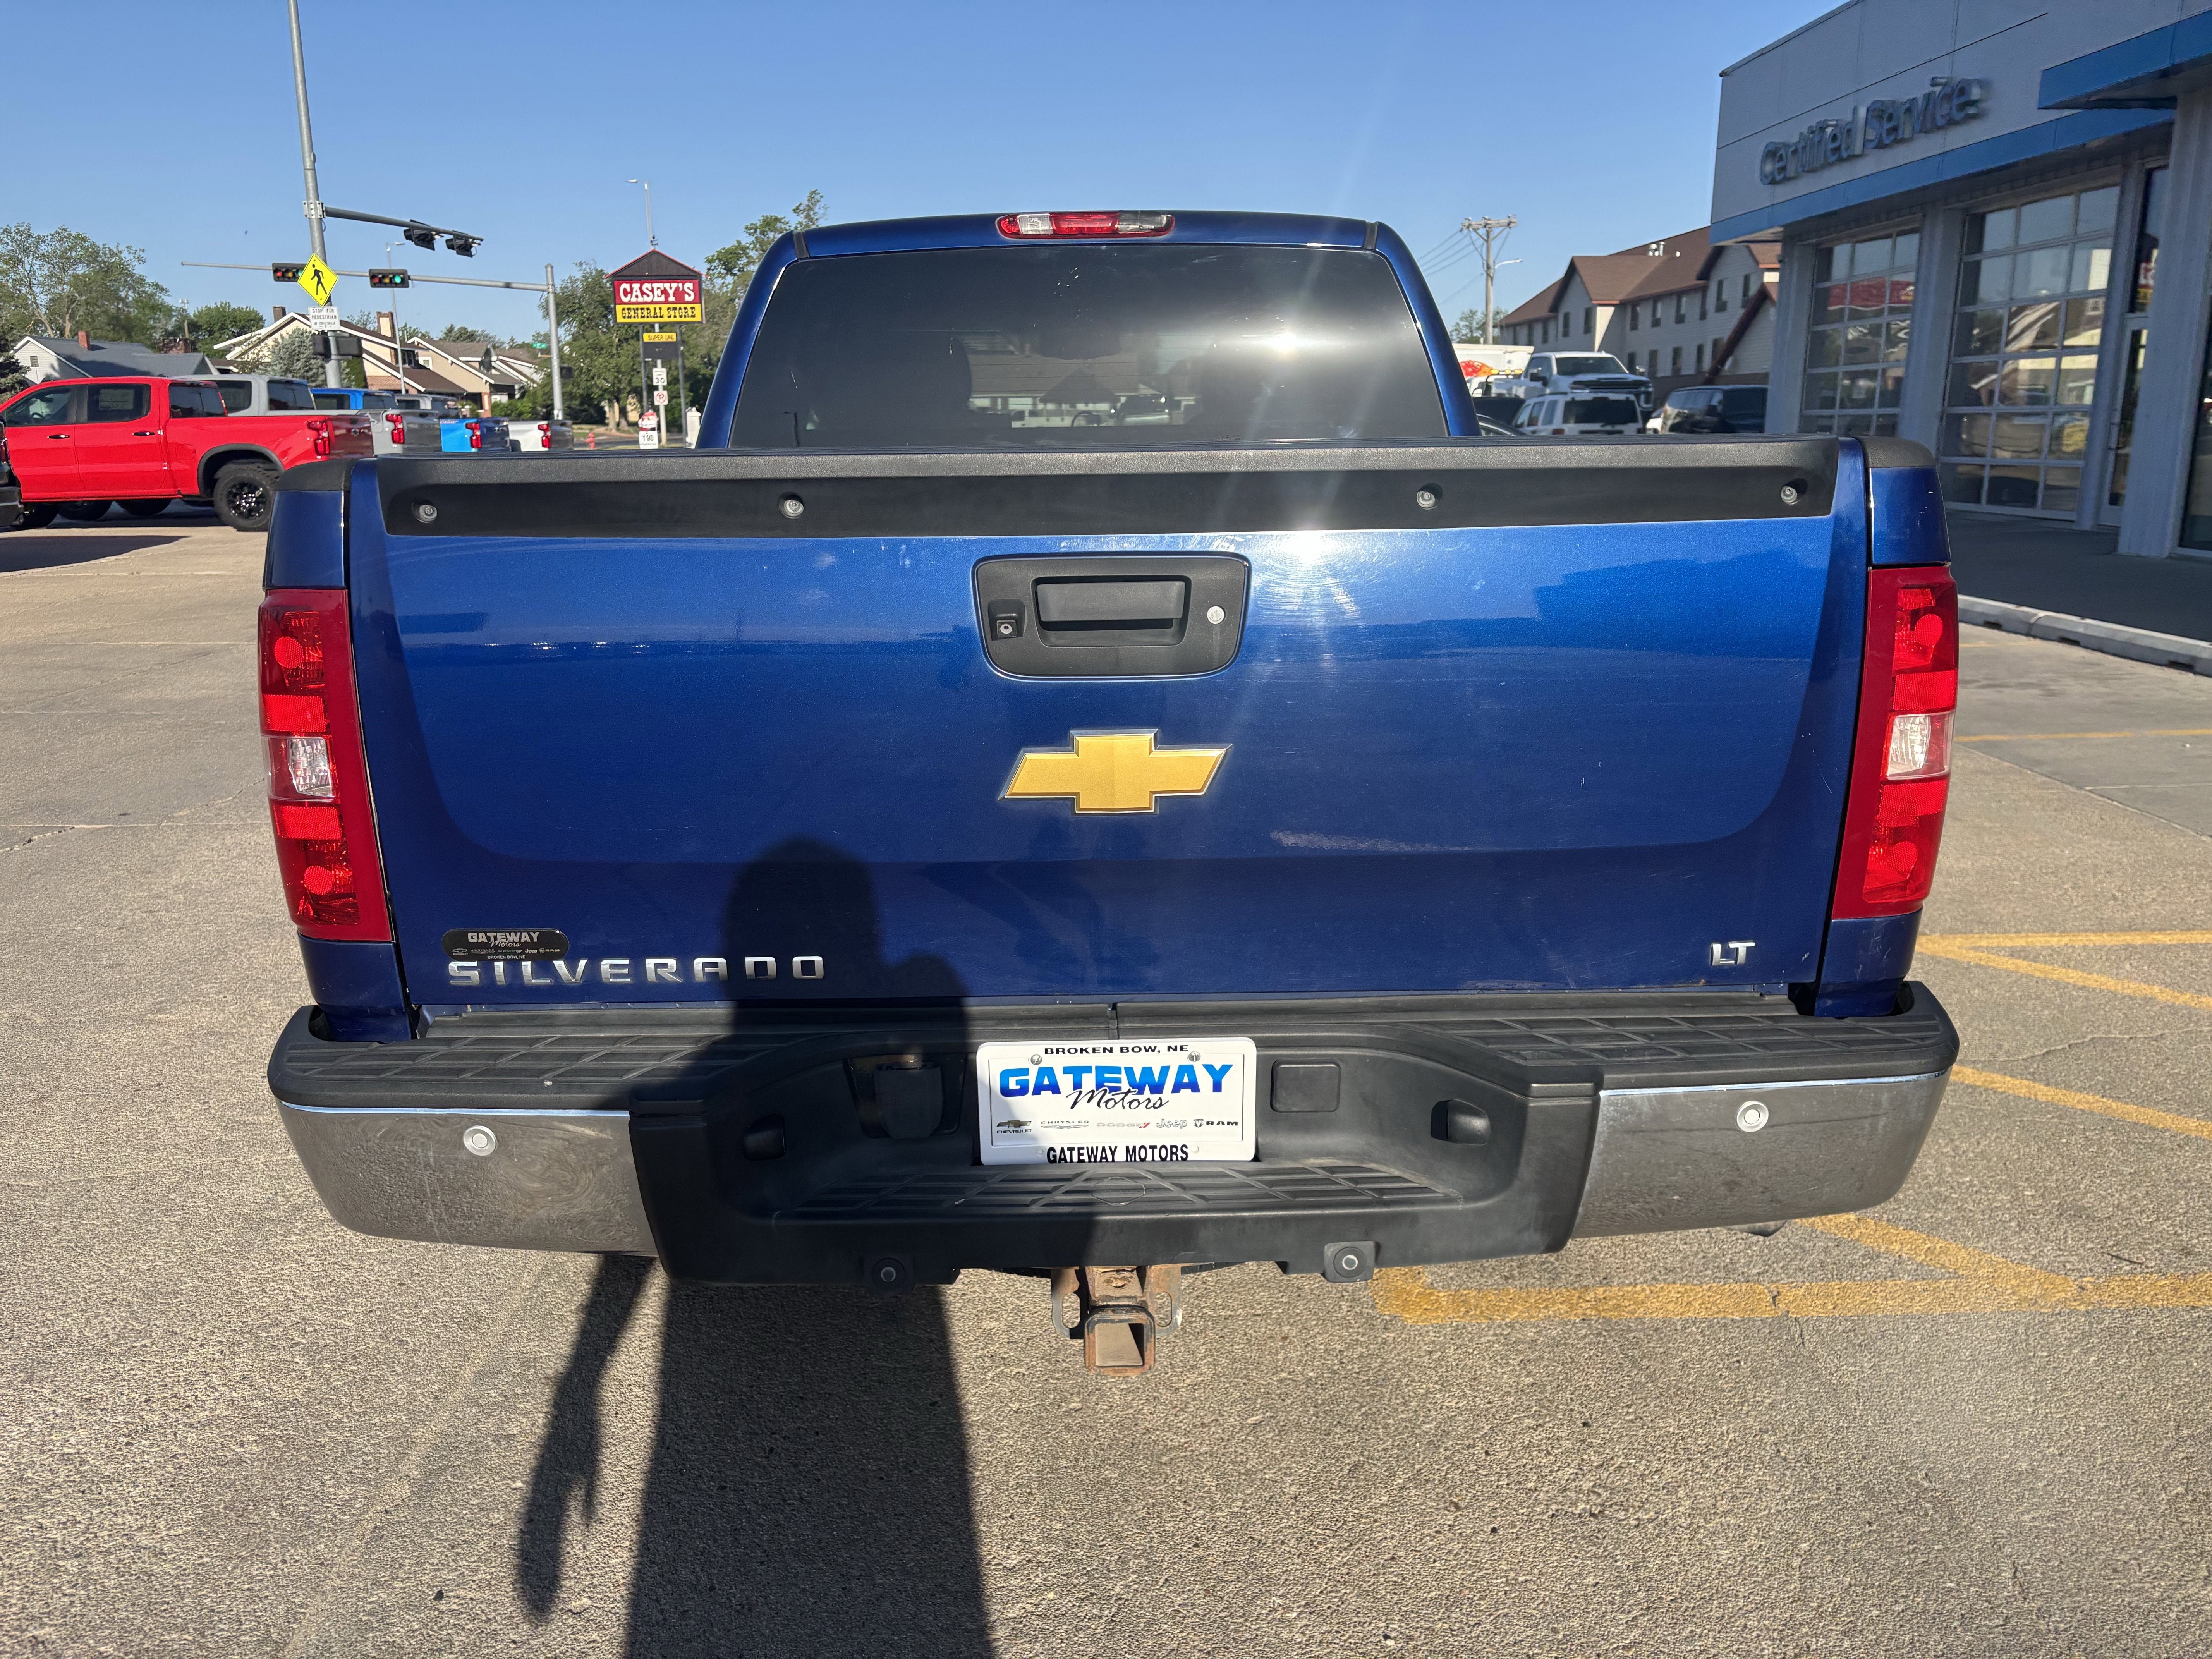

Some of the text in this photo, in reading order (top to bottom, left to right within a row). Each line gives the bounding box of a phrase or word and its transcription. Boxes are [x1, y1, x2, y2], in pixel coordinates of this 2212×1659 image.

[1760, 77, 1981, 185] Certified Service
[620, 282, 695, 302] CASEY'S
[622, 306, 696, 319] GENERAL STORE
[467, 932, 540, 943] GATEWAY
[489, 939, 522, 948] Motors
[1710, 941, 1755, 966] LT
[448, 955, 824, 986] SILVERADO
[1045, 1046, 1113, 1054] BROKEN
[1120, 1046, 1161, 1054] BOW,
[1000, 1064, 1234, 1097] GATEWAY
[1066, 1087, 1170, 1110] Motors
[1156, 1118, 1188, 1129] Jeep
[1047, 1144, 1188, 1164] GATEWAY MOTORS
